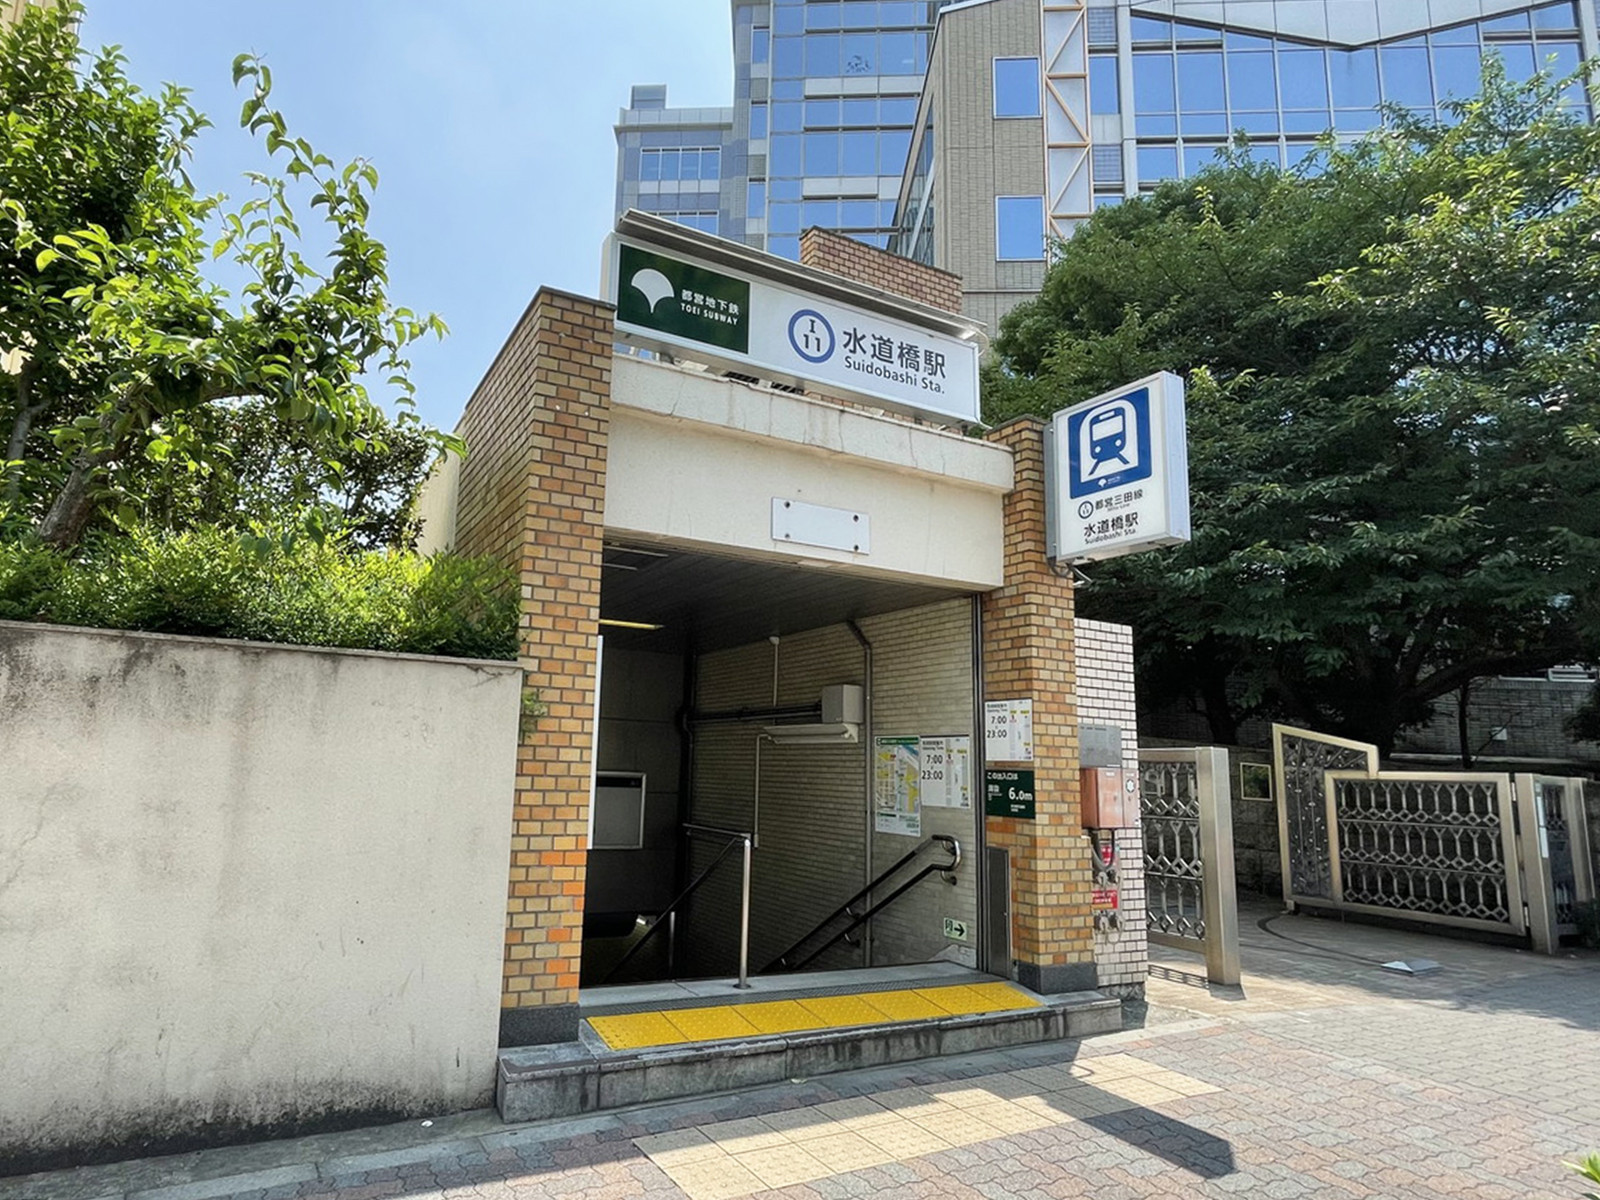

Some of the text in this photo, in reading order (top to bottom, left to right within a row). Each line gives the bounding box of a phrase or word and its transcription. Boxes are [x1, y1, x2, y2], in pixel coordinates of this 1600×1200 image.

[681, 289, 739, 315] 都営地下鉄
[681, 303, 738, 325] TOEI SUBWAY
[809, 319, 816, 334] I
[803, 334, 821, 352] 11
[842, 327, 946, 379] 水道橋駅
[844, 356, 945, 394] Suidobashi Sta.
[1084, 512, 1139, 537] 水道橋駅
[1085, 531, 1122, 544] Suidobashi
[1008, 787, 1033, 800] 6.0m
